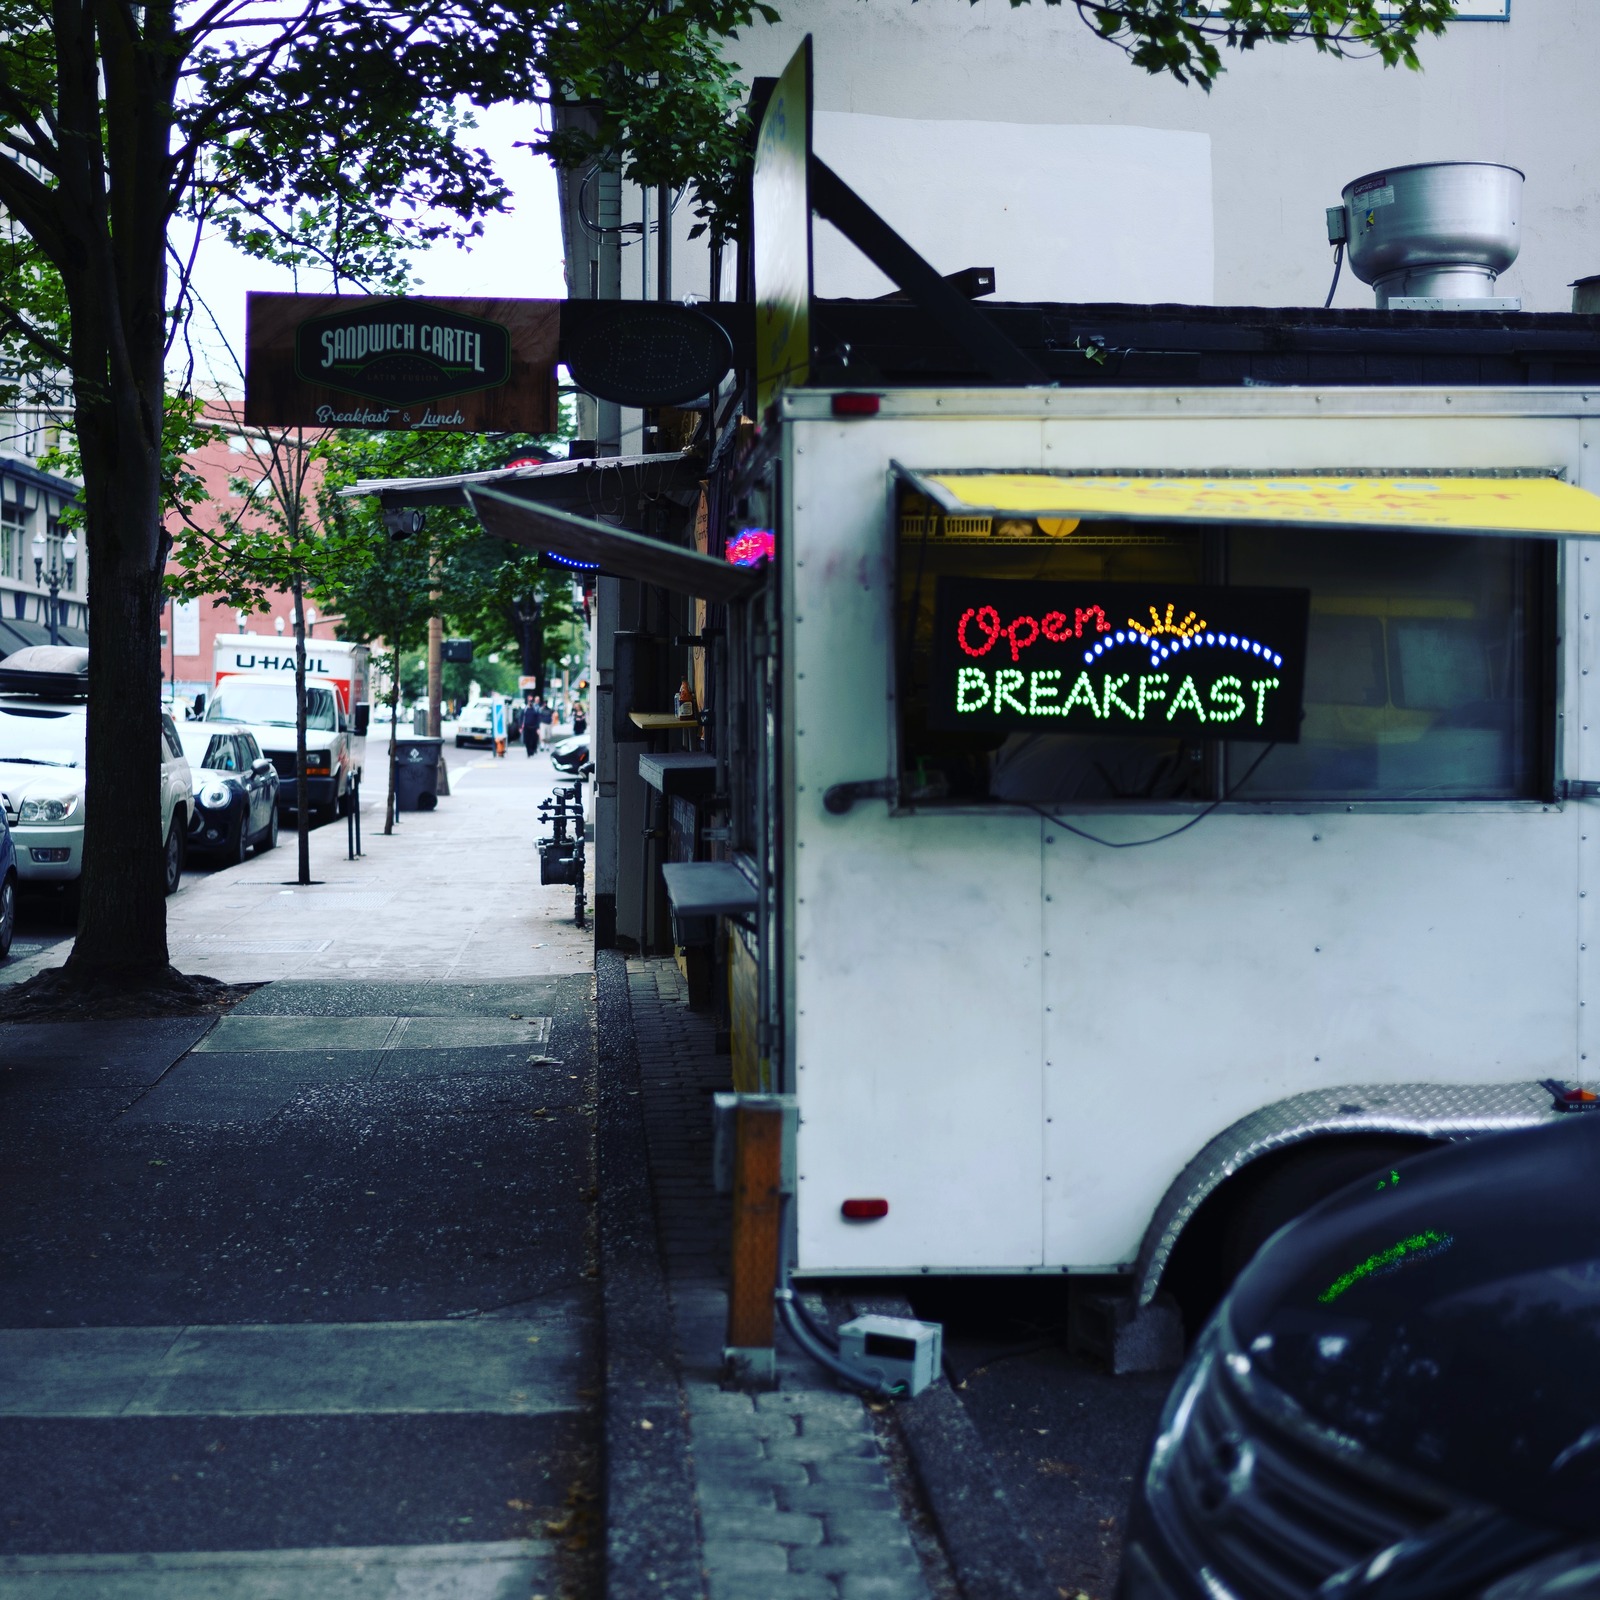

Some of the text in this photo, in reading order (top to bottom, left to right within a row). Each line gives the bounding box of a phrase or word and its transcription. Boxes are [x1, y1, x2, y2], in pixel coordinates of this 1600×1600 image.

[321, 324, 485, 373] SANDWICH CARTEL
[402, 374, 439, 382] FUSION
[316, 405, 465, 429] Breakfast & Lunch
[957, 604, 1111, 662] Open
[236, 654, 330, 673] U-HAUL
[956, 667, 1281, 726] BREAKFAST
